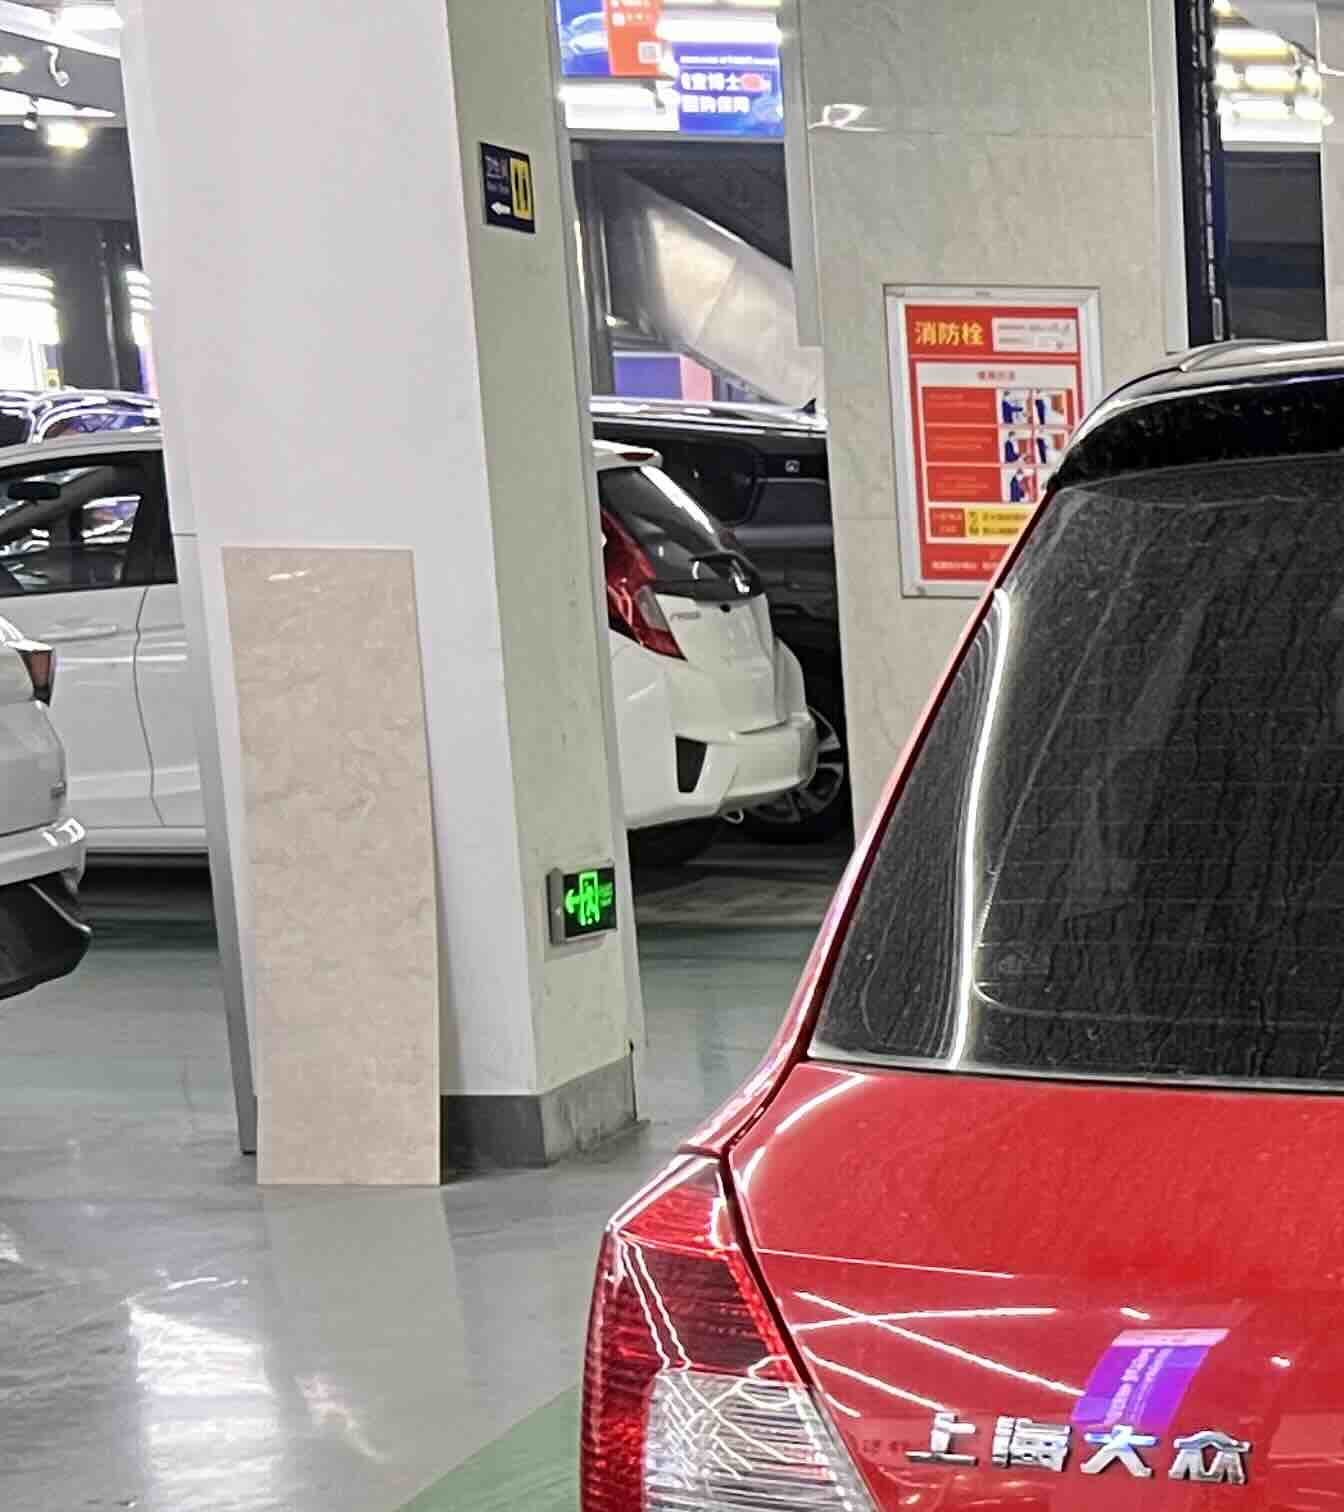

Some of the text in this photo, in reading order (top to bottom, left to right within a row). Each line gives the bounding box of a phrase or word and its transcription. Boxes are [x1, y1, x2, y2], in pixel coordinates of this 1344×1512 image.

[914, 320, 984, 346] 消防栓
[904, 1411, 1251, 1485] 上海大众
